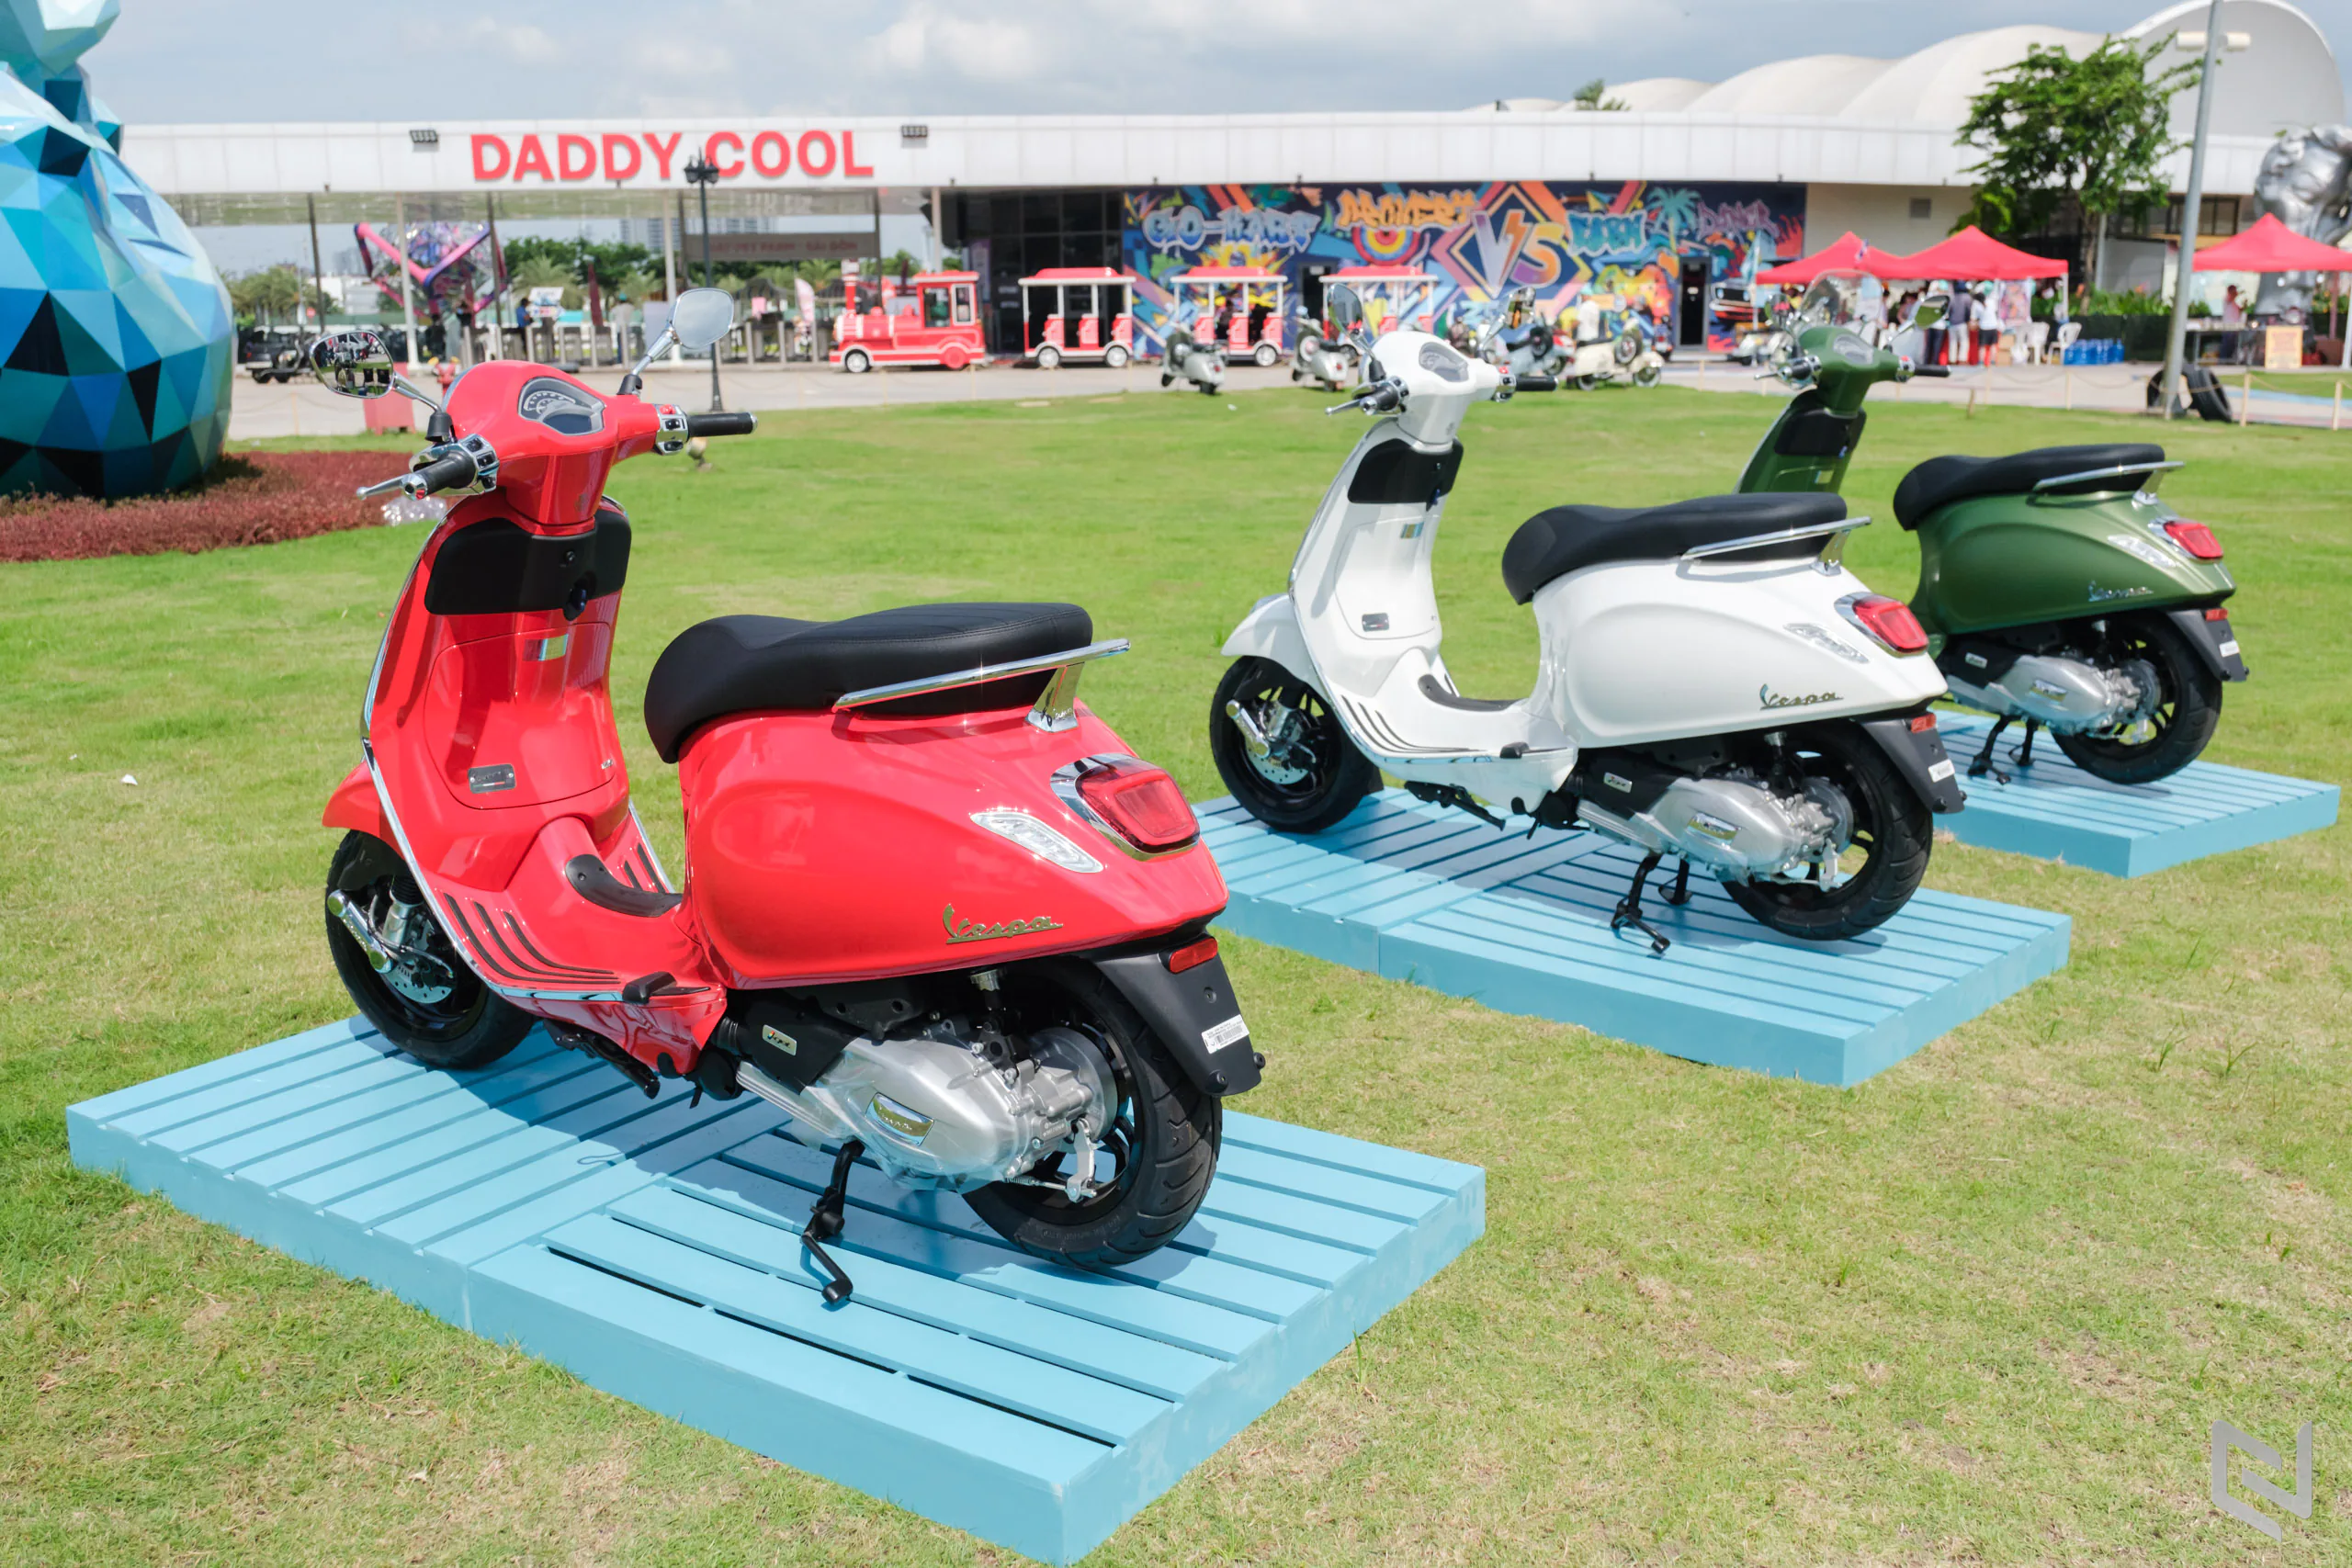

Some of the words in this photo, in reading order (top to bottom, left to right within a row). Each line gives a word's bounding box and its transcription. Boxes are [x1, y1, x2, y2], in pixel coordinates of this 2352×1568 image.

[470, 132, 683, 182] DADDY
[705, 130, 875, 178] COOL
[1142, 204, 1321, 254] GO-KART
[1471, 209, 1566, 299] VS
[1759, 683, 1845, 711] Vespa
[942, 903, 1064, 944] Vespa
